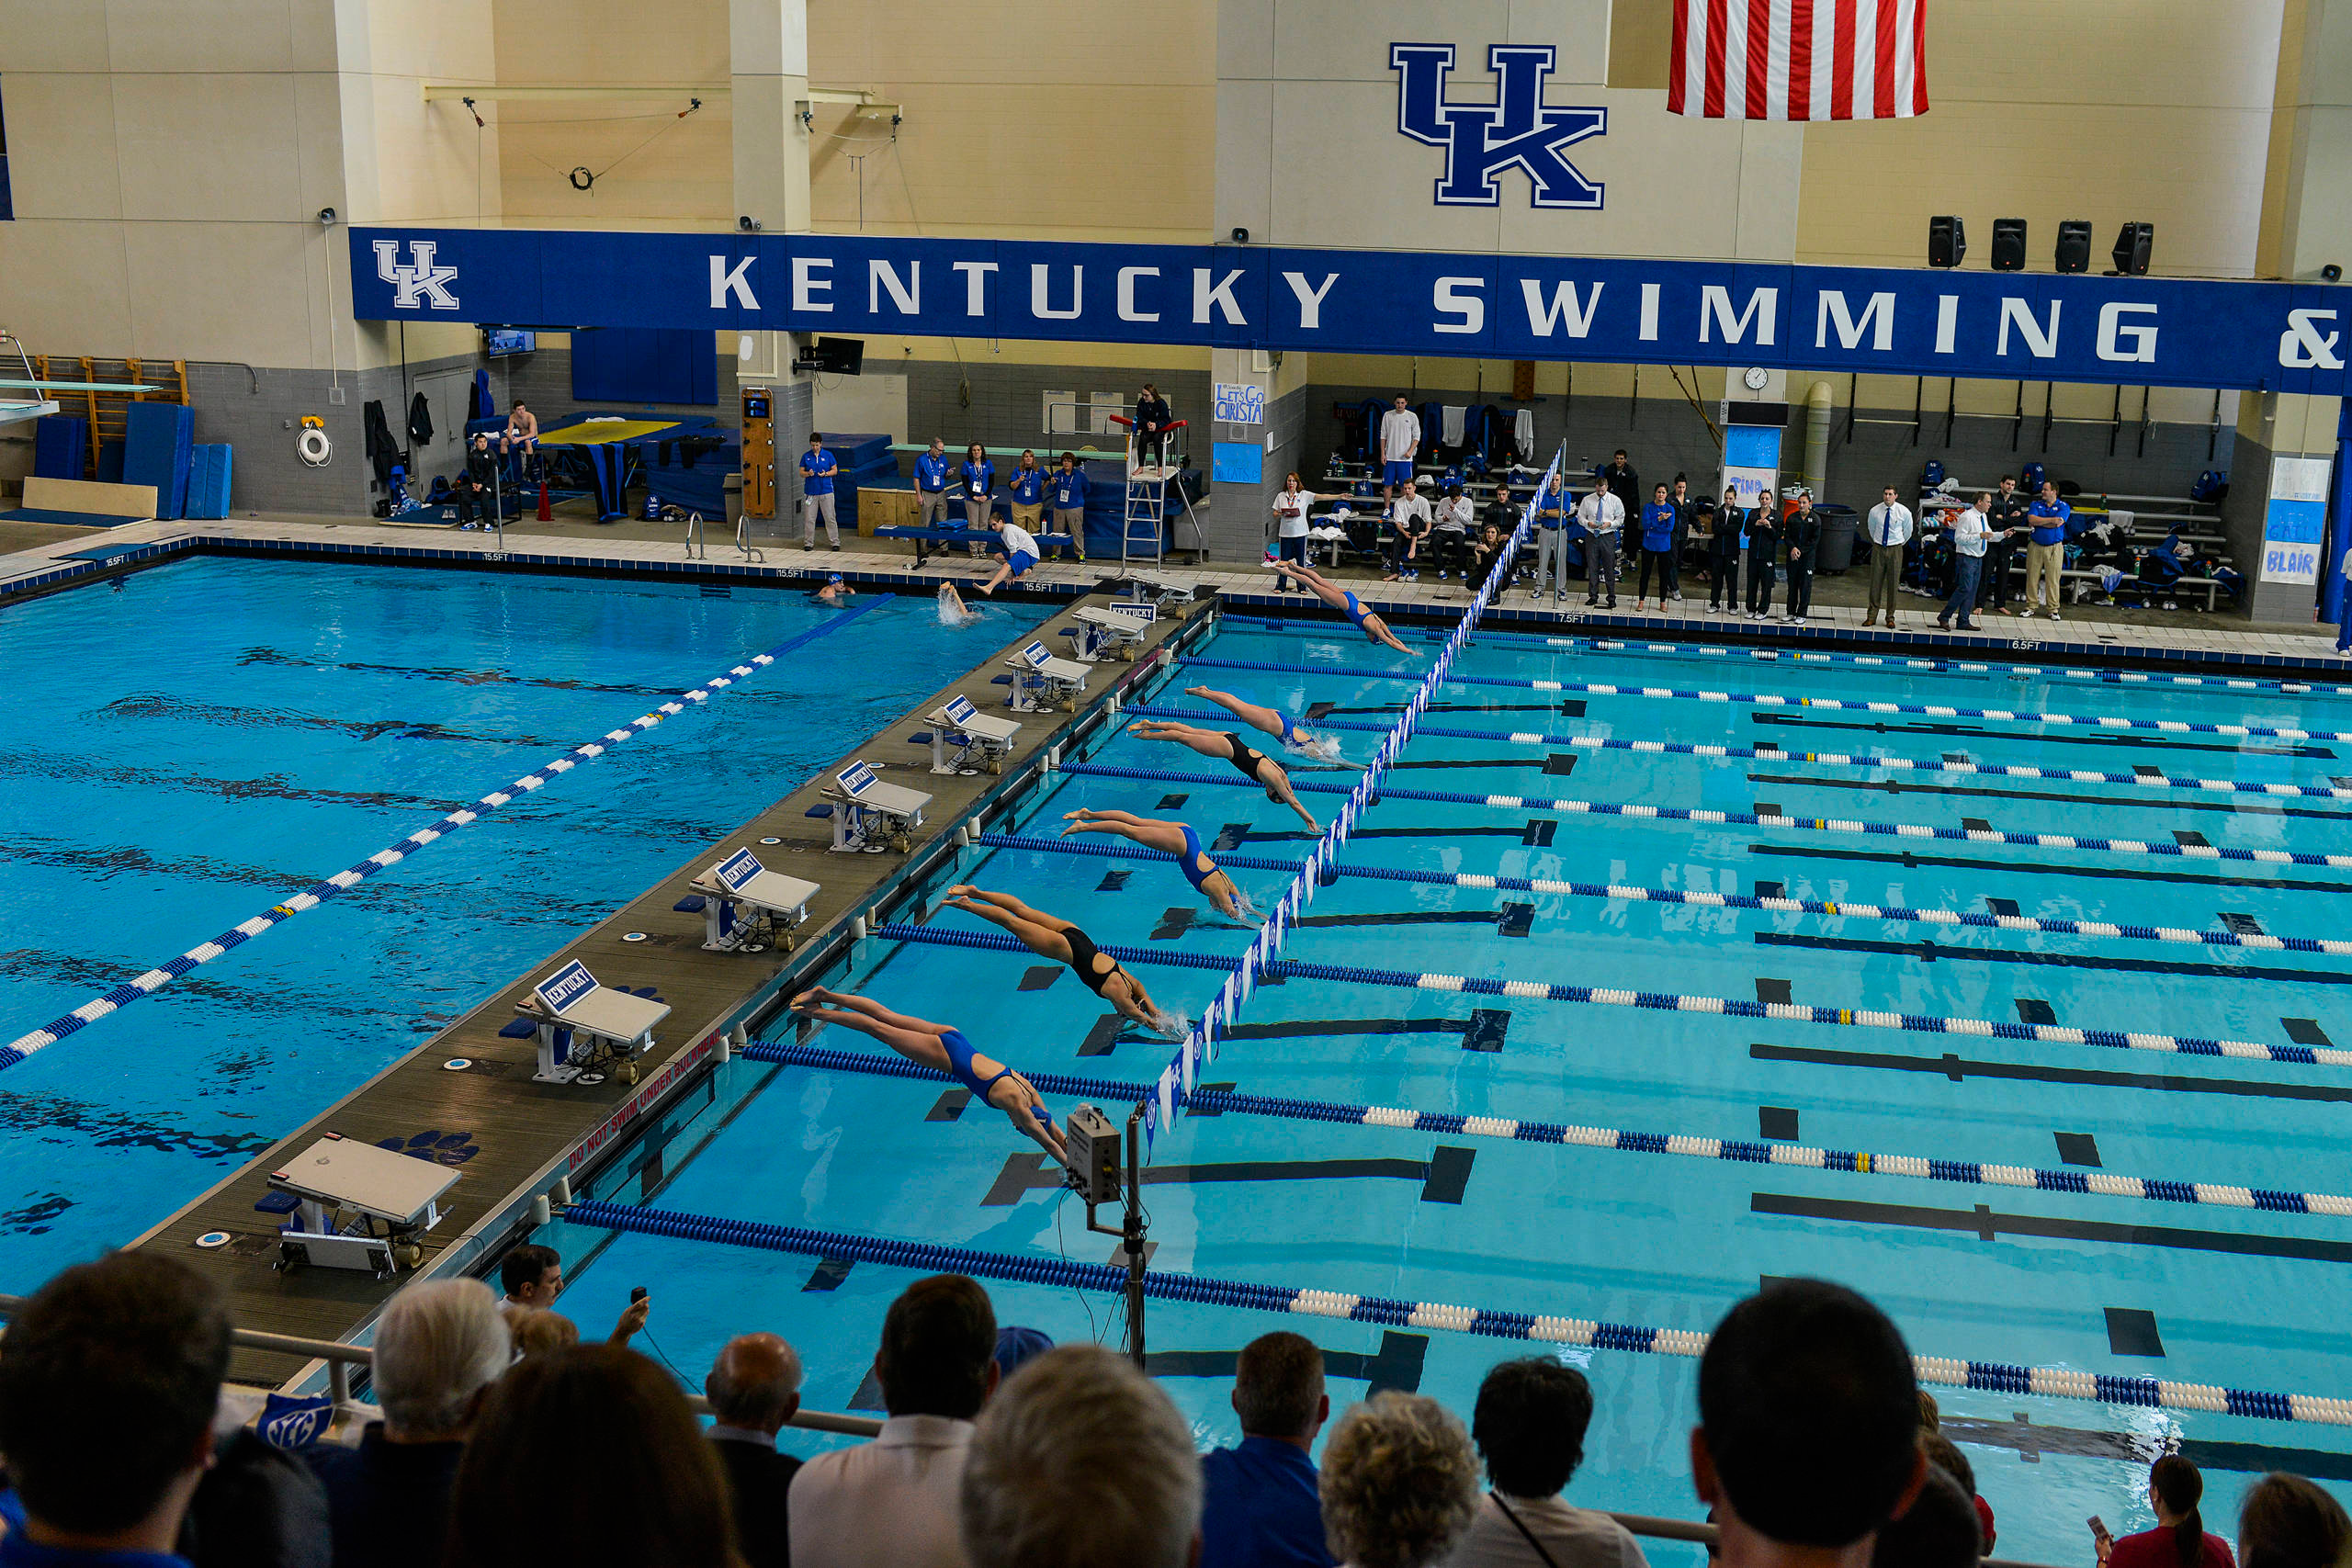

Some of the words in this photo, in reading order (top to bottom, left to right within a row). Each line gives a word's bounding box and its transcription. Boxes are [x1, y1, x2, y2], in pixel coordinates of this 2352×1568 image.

[1389, 42, 1608, 210] UK
[372, 239, 460, 310] UK
[708, 254, 1340, 329] KENTUCKY
[1432, 276, 2159, 364] SWIMMING
[2278, 308, 2346, 369] &
[483, 552, 509, 562] 15.5FT
[777, 569, 805, 579] 15.5FT
[1025, 582, 1054, 592] 15.5FT
[1558, 614, 1586, 625] 7.5FT
[2012, 640, 2041, 651] 6.5FT
[722, 855, 758, 886] KENTUCKY
[544, 967, 591, 1007] KENTUCKY
[569, 1145, 584, 1170] DO
[586, 1125, 613, 1152] NOT
[611, 1099, 639, 1134] SWIM
[640, 1070, 673, 1108] UNDER
[674, 1028, 721, 1077] BULKHEAD
